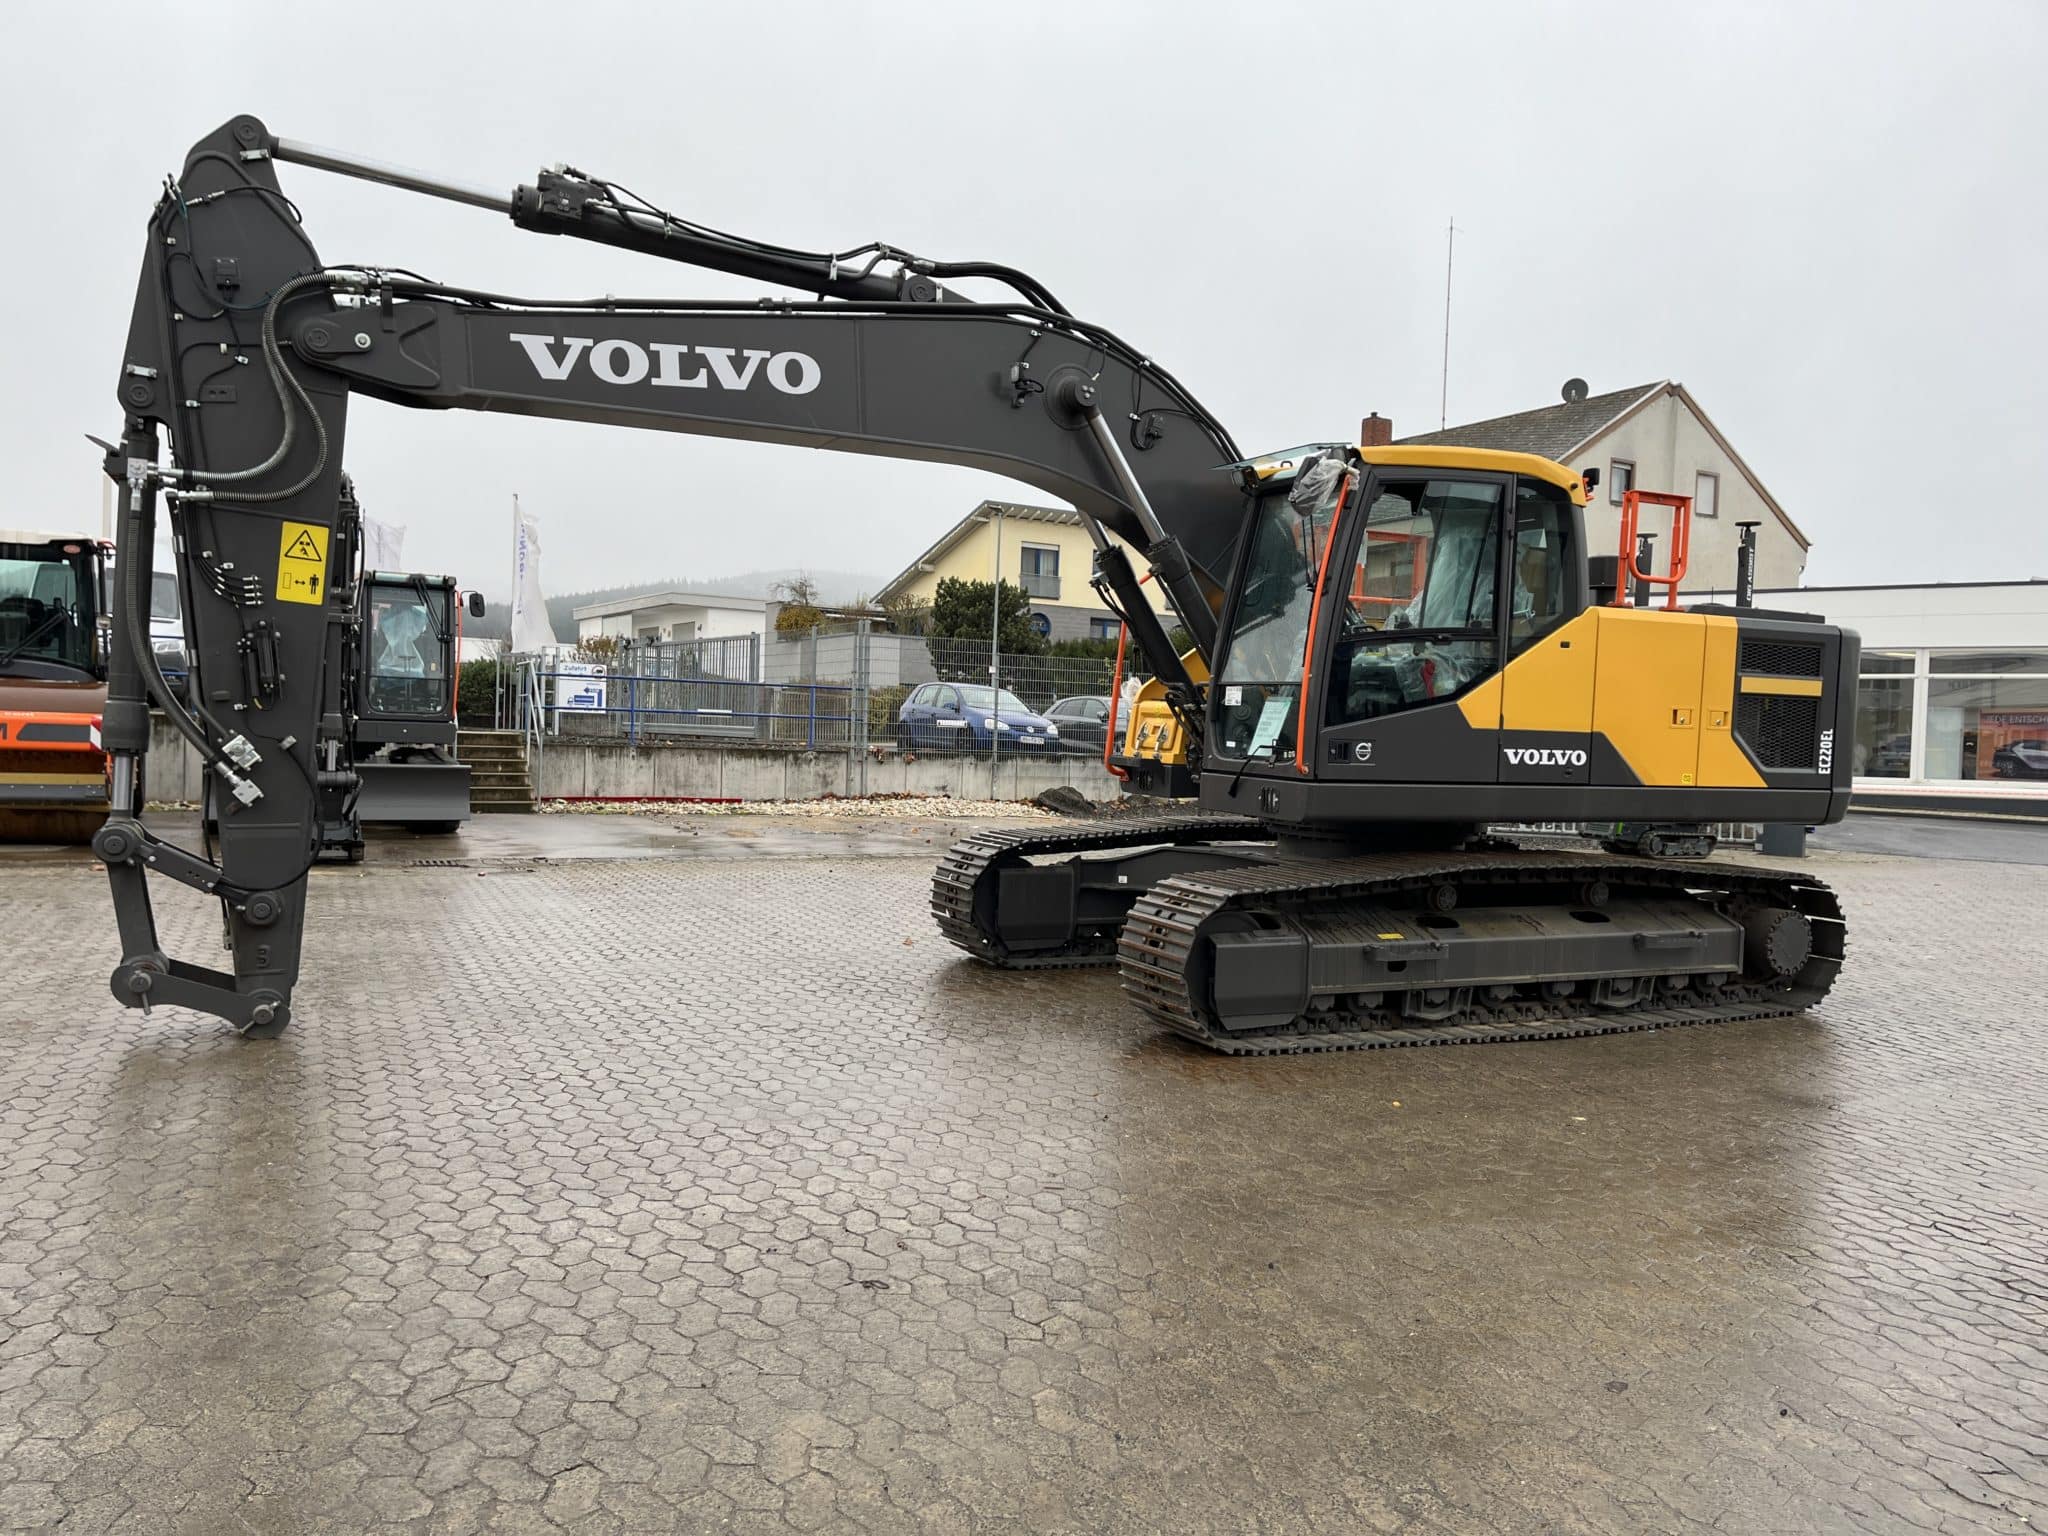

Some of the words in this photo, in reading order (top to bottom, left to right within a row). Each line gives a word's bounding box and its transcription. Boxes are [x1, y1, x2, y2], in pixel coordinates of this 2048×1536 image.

[510, 333, 821, 394] VOLVO
[1503, 749, 1587, 766] VOLVO
[1818, 728, 1833, 774] EC220EL
